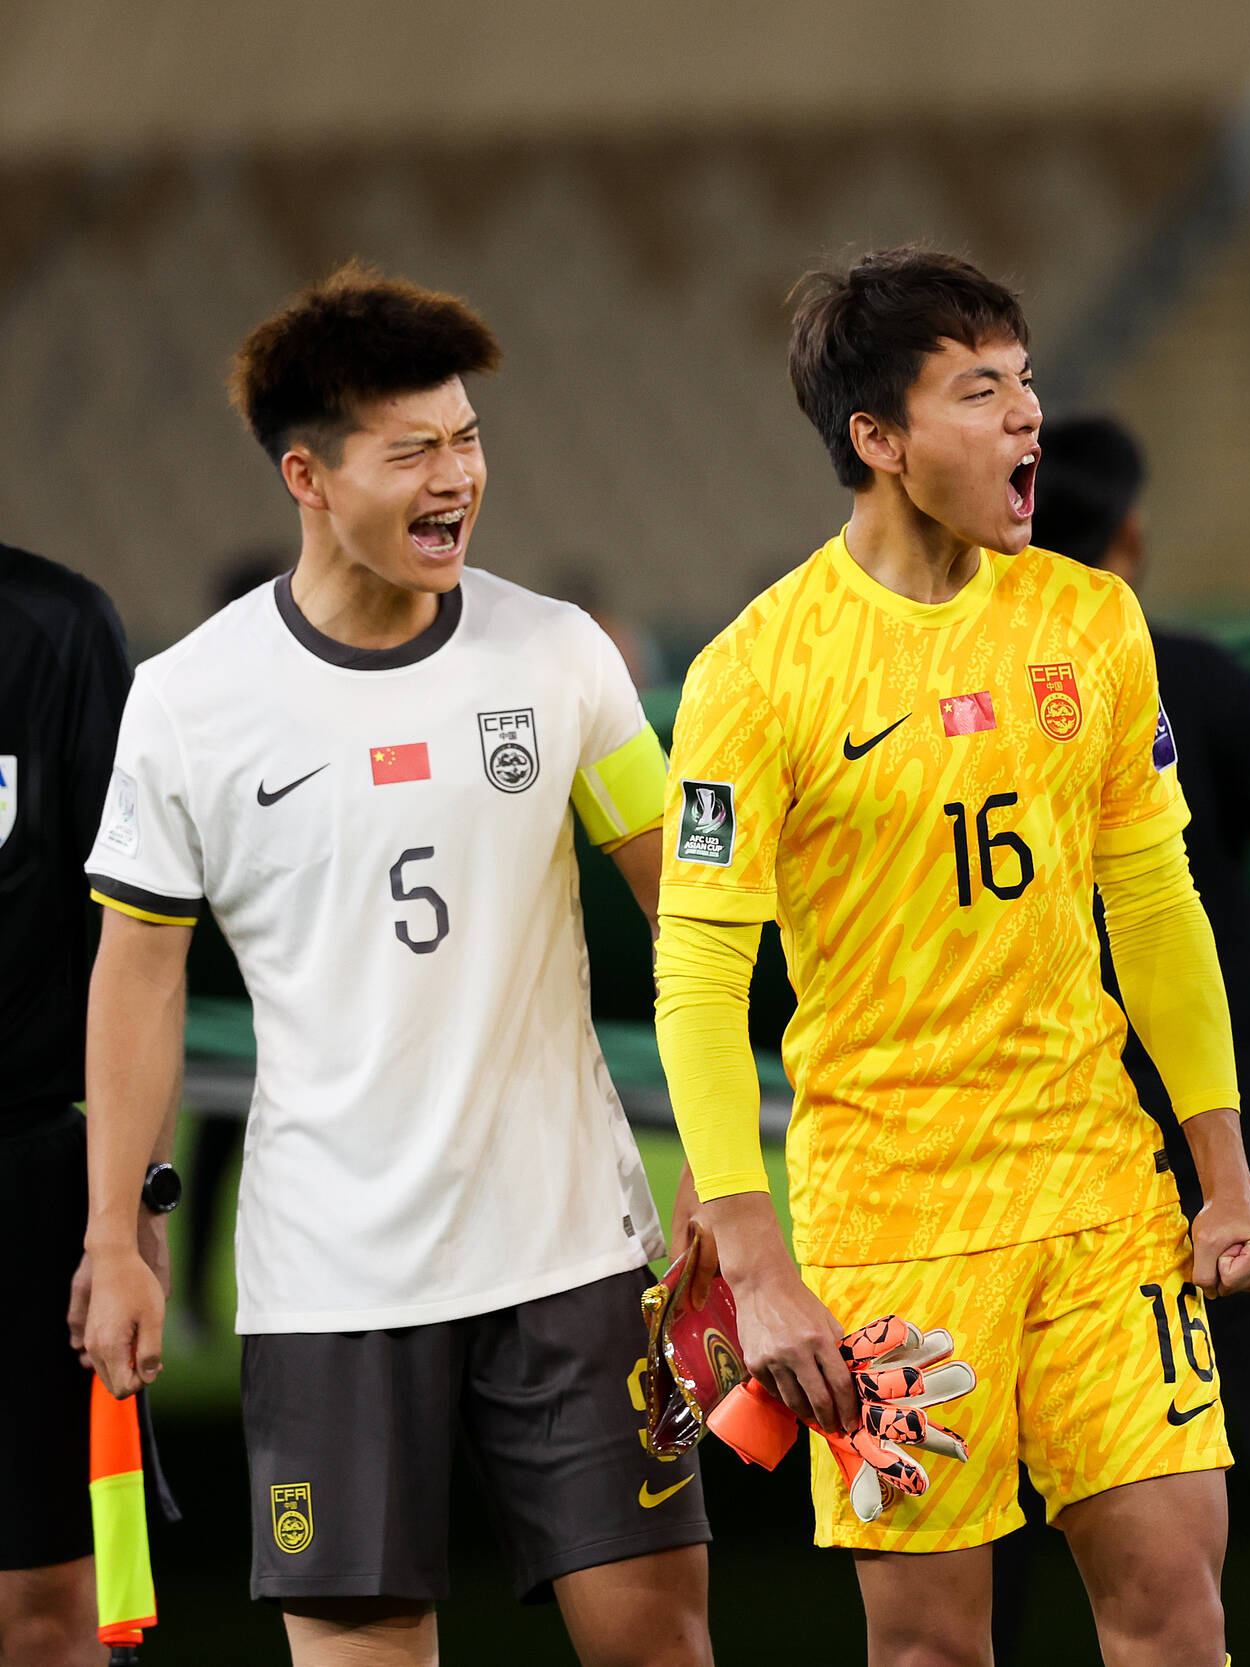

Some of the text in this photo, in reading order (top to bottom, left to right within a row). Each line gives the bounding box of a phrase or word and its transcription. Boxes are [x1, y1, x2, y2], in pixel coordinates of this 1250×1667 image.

[1031, 665, 1073, 682] CFA
[483, 715, 530, 732] CFA
[684, 841, 723, 852] ASIAN CUP
[689, 834, 719, 845] AFC U23
[944, 792, 1035, 907] 16
[389, 845, 450, 954] 5
[1140, 1282, 1217, 1384] 16
[275, 1487, 307, 1503] CFA
